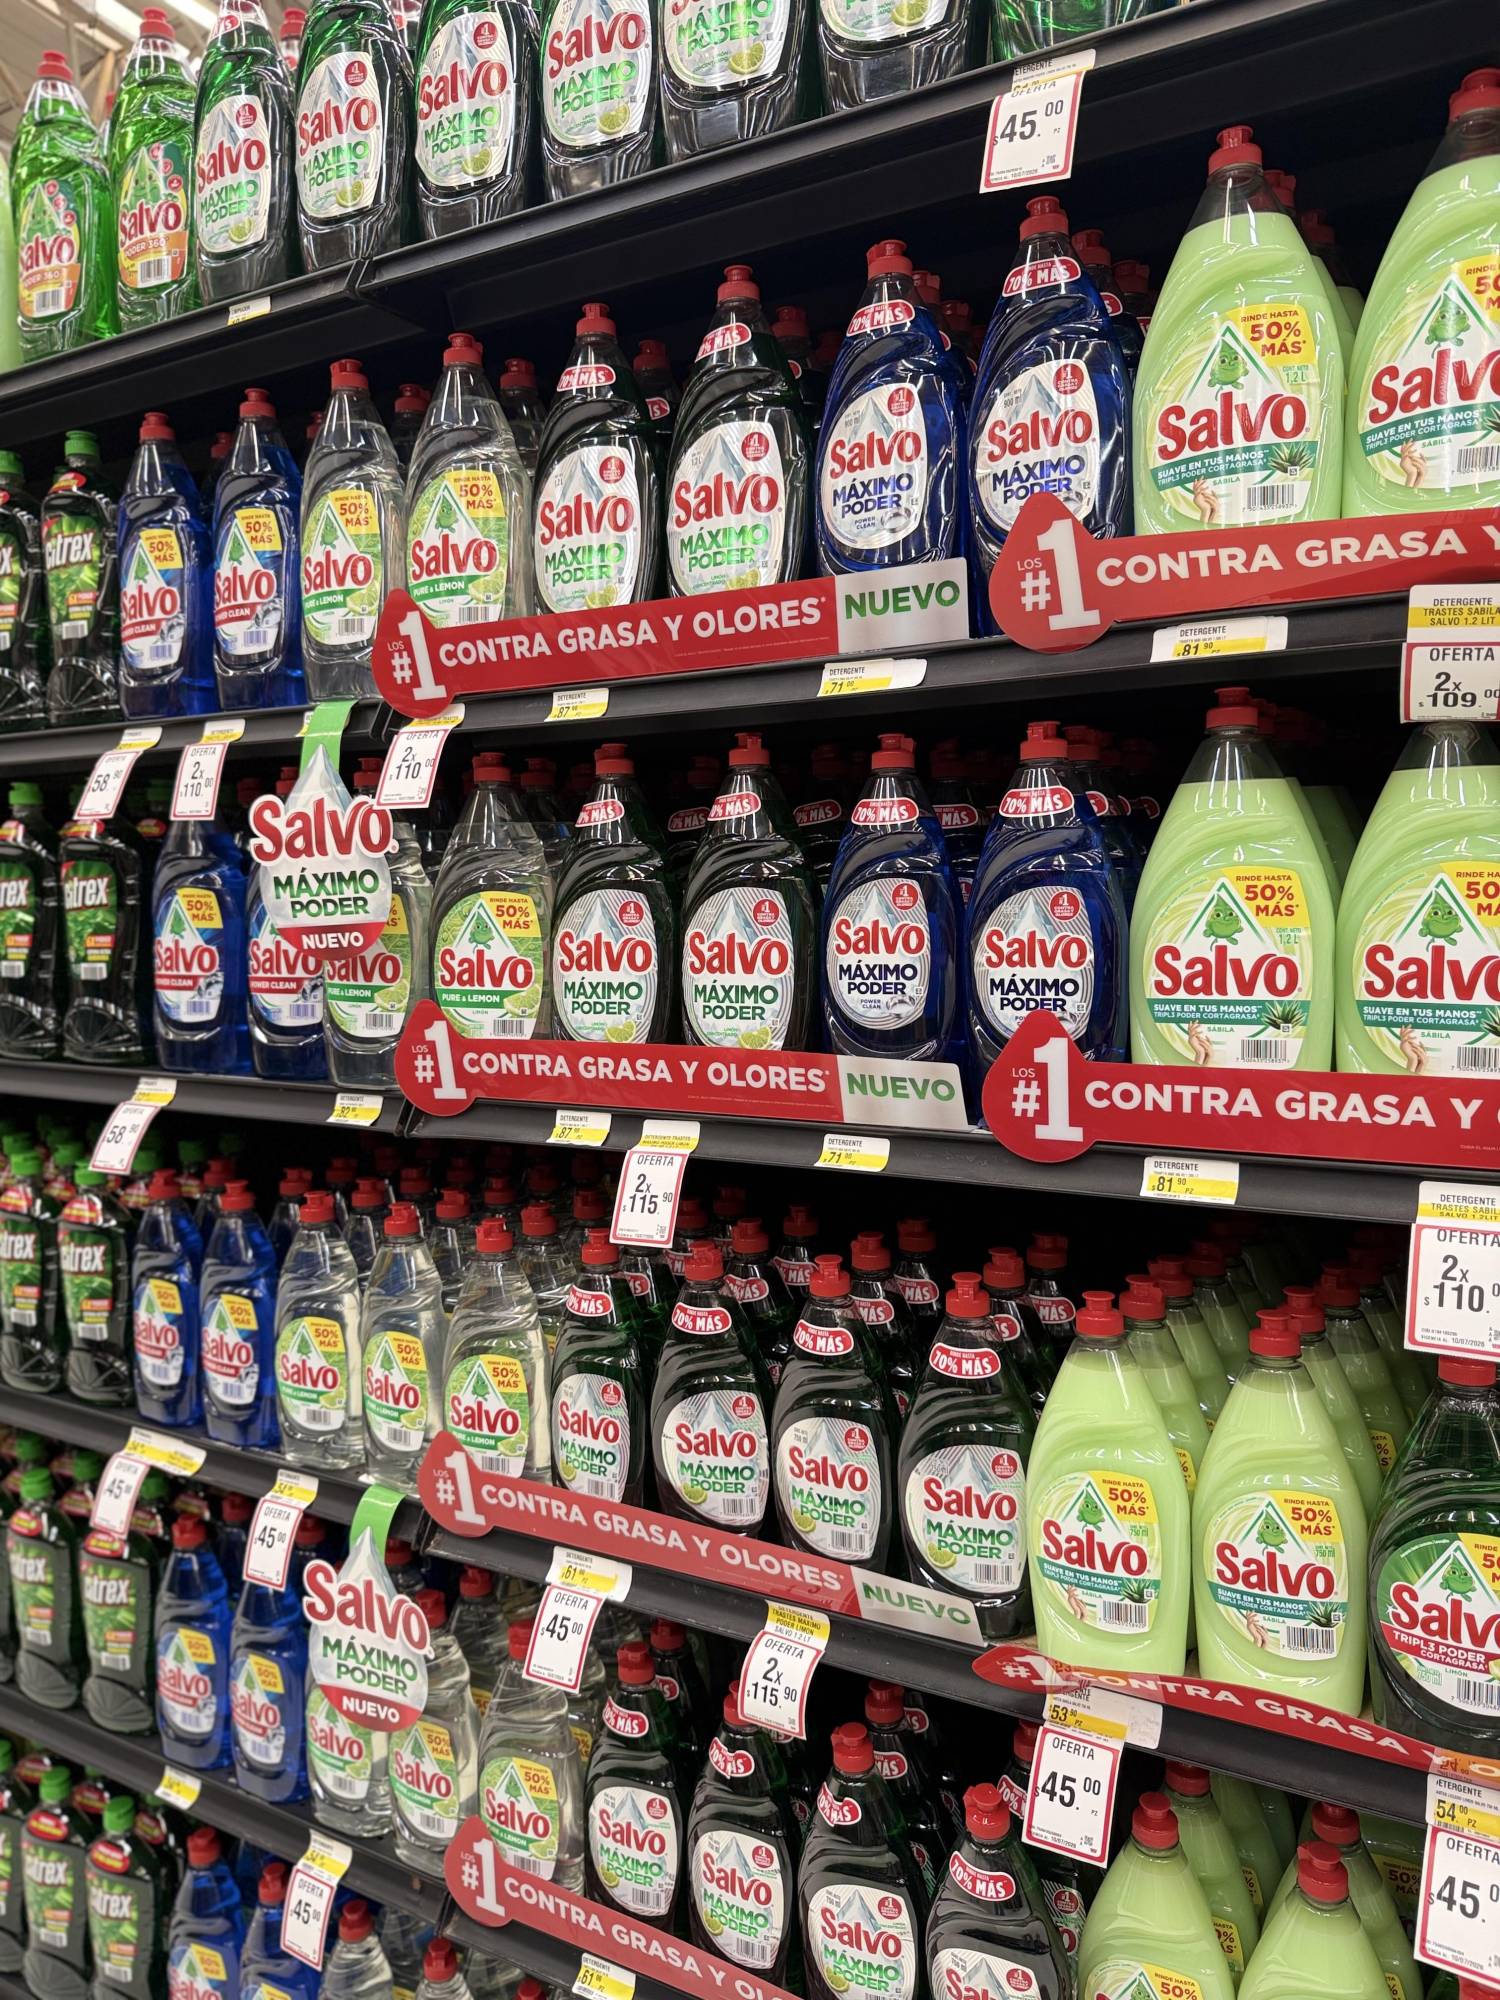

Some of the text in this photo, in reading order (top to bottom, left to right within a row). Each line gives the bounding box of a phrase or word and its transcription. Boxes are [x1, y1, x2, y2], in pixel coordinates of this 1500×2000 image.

[548, 11, 646, 80] Salvo
[687, 20, 759, 58] PODER
[418, 59, 507, 120] Salvo
[553, 59, 637, 106] MÁXIMO
[562, 86, 624, 118] PODER
[300, 96, 376, 155] Salvo
[424, 105, 498, 144] MÁXIMO
[432, 129, 487, 154] PODER
[303, 139, 369, 178] MÁXIMO
[308, 163, 358, 193] PODER
[1240, 309, 1299, 324] RINDE HASTA
[1250, 321, 1301, 342] 50%
[988, 409, 1093, 463] Salvo
[1158, 392, 1306, 460] Salvo
[830, 430, 922, 479] Salvo
[1158, 466, 1186, 480] SUAVE
[1188, 461, 1201, 472] EN
[1203, 457, 1222, 469] TUS
[992, 455, 1086, 492] MÁXIMO
[459, 484, 494, 499] 50%
[674, 473, 779, 528] Salvo
[832, 473, 913, 507] MÁXIMO
[841, 494, 901, 518] PODER
[339, 502, 369, 517] 50%
[540, 494, 634, 545] Salvo
[245, 520, 272, 534] 50%
[680, 523, 768, 560] MÁXIMO
[149, 541, 175, 554] 50%
[412, 533, 497, 581] Salvo
[544, 542, 625, 574] MÁXIMO
[1097, 543, 1283, 586] CONTRA
[1296, 528, 1466, 567] GRASA
[304, 551, 372, 593] Salvo
[1017, 558, 1042, 570] LOS
[845, 580, 960, 619] NUEVO
[1424, 607, 1463, 617] TRASTES
[1433, 597, 1493, 607] DETERGENTE
[1180, 626, 1226, 637] DETERGENTE
[1430, 616, 1496, 626] SALVO 1.2 LIT
[439, 632, 551, 667] CONTRA
[557, 618, 656, 654] GRASA
[663, 614, 684, 637] Y
[1429, 647, 1495, 662] OFERTA
[829, 667, 865, 676] DETERGENTE
[879, 803, 909, 821] MÁS
[252, 797, 393, 862] Salvo
[273, 868, 380, 901] MÁXIMO
[1244, 885, 1295, 901] 50%
[292, 896, 369, 919] PODER
[496, 905, 530, 918] 50%
[302, 932, 364, 952] NUEVO
[559, 931, 652, 974] Salvo
[834, 918, 926, 955] Salvo
[984, 928, 1087, 968] Salvo
[440, 950, 533, 988] Salvo
[689, 931, 788, 976] Salvo
[838, 961, 918, 981] MÁXIMO
[989, 976, 1079, 996] MÁXIMO
[1153, 945, 1300, 997] Salvo
[564, 977, 643, 1000] MÁXIMO
[694, 981, 778, 1005] MÁXIMO
[847, 981, 907, 995] PODER
[571, 1002, 630, 1015] PODER
[702, 1006, 766, 1020] PODER
[412, 1045, 428, 1053] LOS
[463, 1051, 566, 1078] CONTRA
[579, 1057, 672, 1083] GRASA
[680, 1061, 699, 1084] Y
[847, 1072, 956, 1101] NUEVO
[1085, 1082, 1263, 1118] CONTRA
[1275, 1092, 1436, 1128] GRASA
[1450, 1099, 1484, 1129] Y
[637, 1155, 674, 1167] OFERTA
[1154, 1161, 1199, 1171] DETERGENTE
[1432, 1203, 1470, 1212] TRASTES
[1440, 1194, 1496, 1206] DETERGENTE
[1437, 1229, 1500, 1247] OFERTA
[314, 1327, 339, 1340] 50%
[491, 1367, 520, 1379] 50%
[450, 1395, 520, 1435] Salvo
[559, 1403, 620, 1444] Salvo
[676, 1423, 757, 1457] Salvo
[789, 1446, 869, 1491] Salvo
[690, 1477, 745, 1493] PODER
[923, 1476, 1017, 1521] Salvo
[1108, 1488, 1146, 1503] 50%
[481, 1484, 588, 1526] CONTRA
[594, 1514, 685, 1551] GRASA
[692, 1535, 711, 1556] Y
[1291, 1507, 1332, 1523] 50%
[926, 1518, 1013, 1546] MÁXIMO
[1043, 1519, 1149, 1577] Salvo
[1217, 1541, 1336, 1598] Salvo
[306, 1565, 430, 1650] Salvo
[555, 1592, 588, 1610] OFERTA
[862, 1582, 971, 1625] NUEVO
[323, 1637, 418, 1681] MÁXIMO
[765, 1638, 804, 1659] OFERTA
[1393, 1631, 1485, 1663] TRIPL3 PODER
[337, 1665, 407, 1696] PODER
[343, 1696, 399, 1723] NUEVO
[1073, 1671, 1243, 1715] CONTRA
[1254, 1699, 1409, 1755] GRASA
[1052, 1737, 1095, 1760] OFERTA
[599, 1809, 666, 1855] Salvo
[600, 1845, 663, 1878] MÁXIMO
[1446, 1838, 1500, 1864] OFERTA
[703, 1853, 772, 1905] Salvo
[504, 1879, 604, 1935] CONTRA
[612, 1925, 703, 1977] GRASA
[708, 1964, 727, 1986] Y
[821, 1908, 901, 1956] Salvo
[1160, 1982, 1197, 1999] 50%
